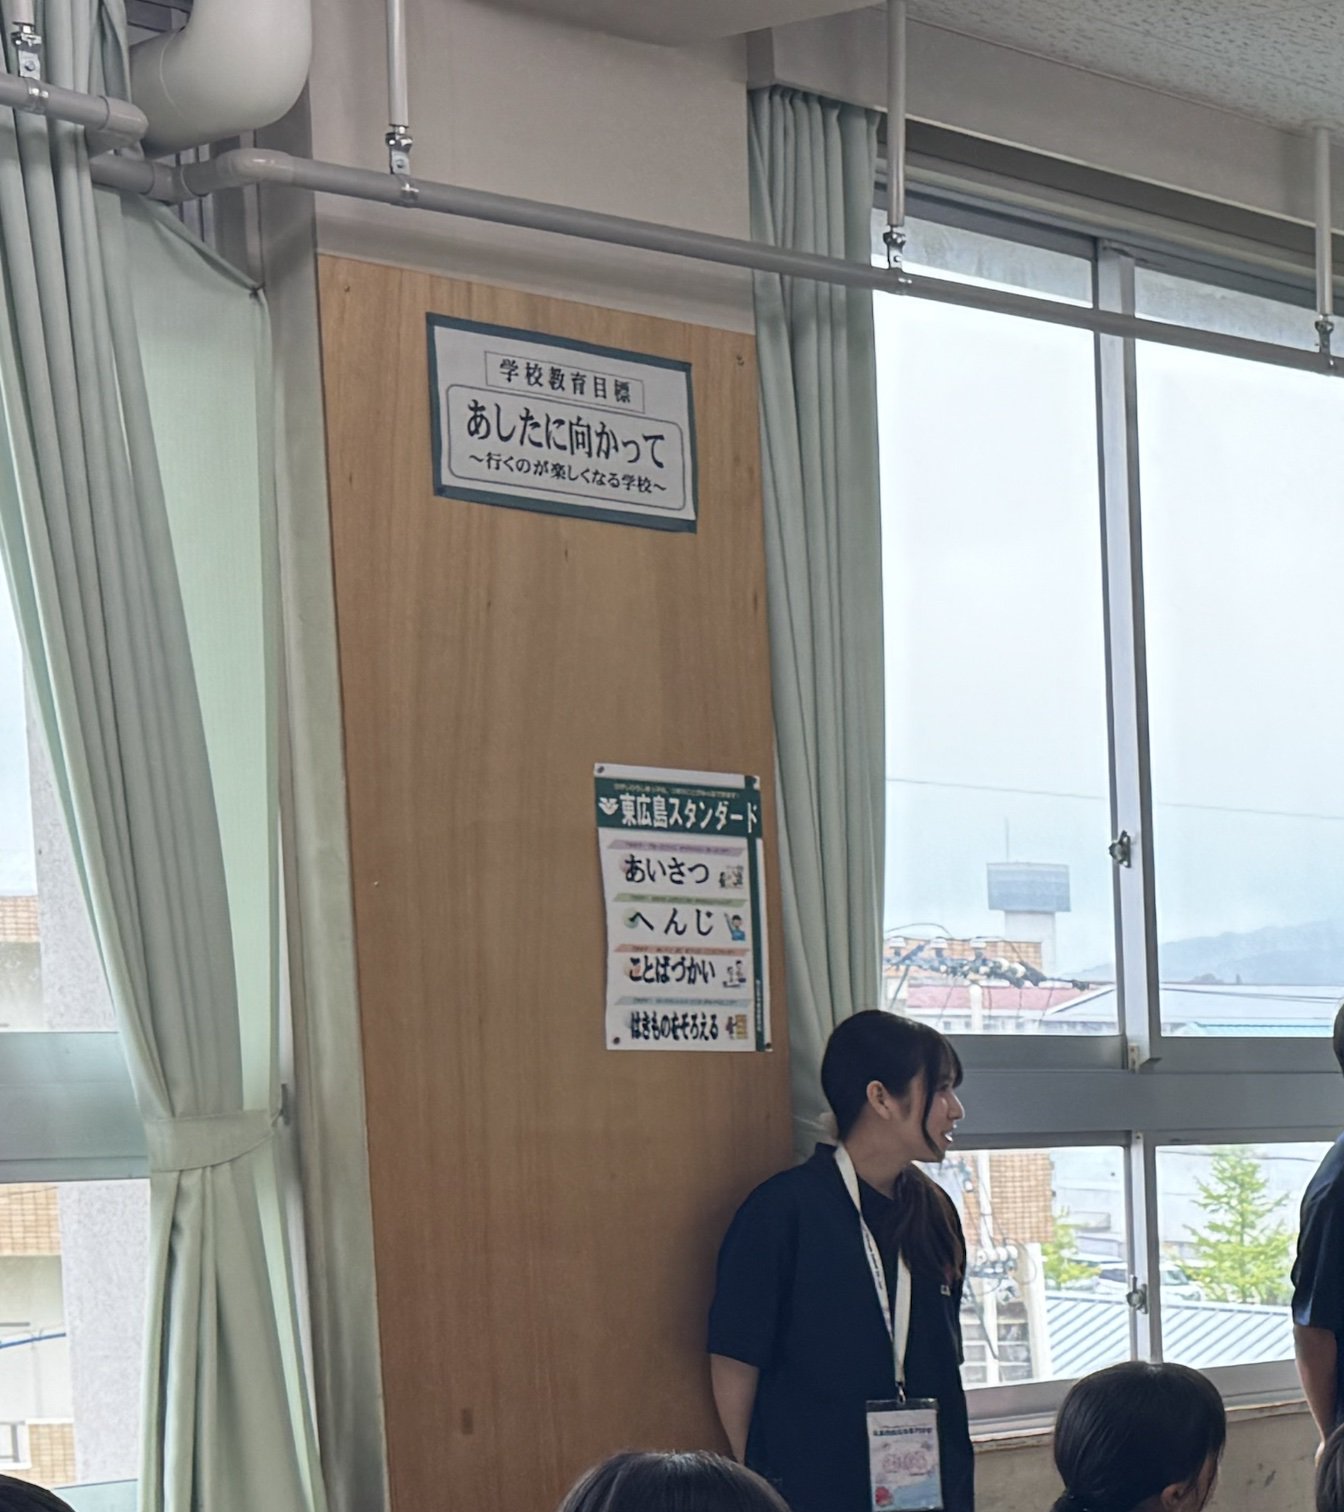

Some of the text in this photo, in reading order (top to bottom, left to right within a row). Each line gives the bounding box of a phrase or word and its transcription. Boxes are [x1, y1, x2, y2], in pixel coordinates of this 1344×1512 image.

[500, 358, 630, 403] 学校教育目標
[467, 399, 665, 468] あしたに向かって
[620, 793, 757, 833] 東広島スタンダード
[624, 854, 709, 885] あいさつ
[628, 907, 714, 936] へんじ
[629, 956, 715, 984] ことばづかい
[631, 1011, 719, 1041] はきものをそろえる
